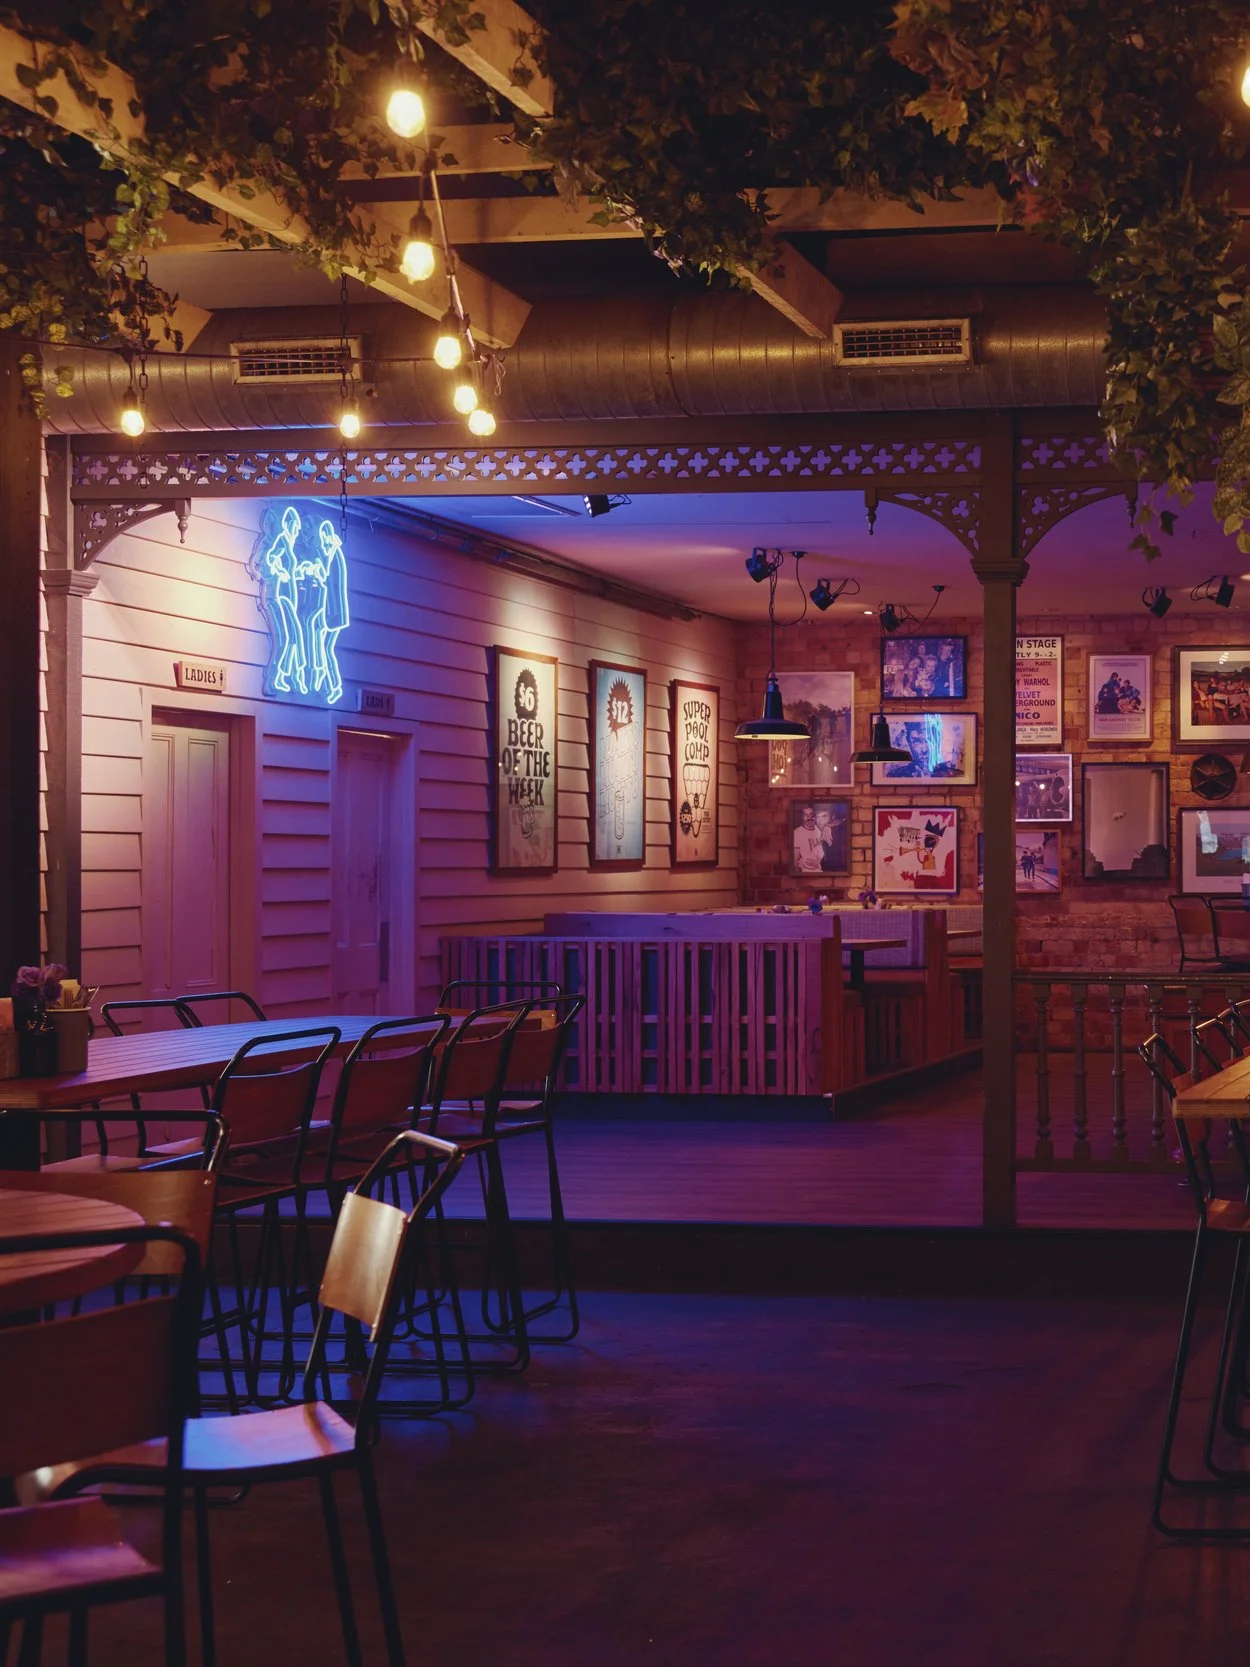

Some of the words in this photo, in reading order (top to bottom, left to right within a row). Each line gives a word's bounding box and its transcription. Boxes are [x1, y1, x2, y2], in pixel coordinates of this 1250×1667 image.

[1027, 640, 1057, 649] STAGE
[185, 668, 217, 684] LADIES
[1024, 678, 1050, 686] WARHOL
[519, 682, 536, 712] $6
[611, 697, 629, 724] $12
[684, 701, 711, 724] SUPER
[508, 719, 545, 750] BEER
[685, 722, 709, 744] POOL
[502, 747, 521, 776] OF
[526, 751, 551, 779] THE
[685, 744, 710, 763] COMP
[508, 777, 545, 806] WEEK
